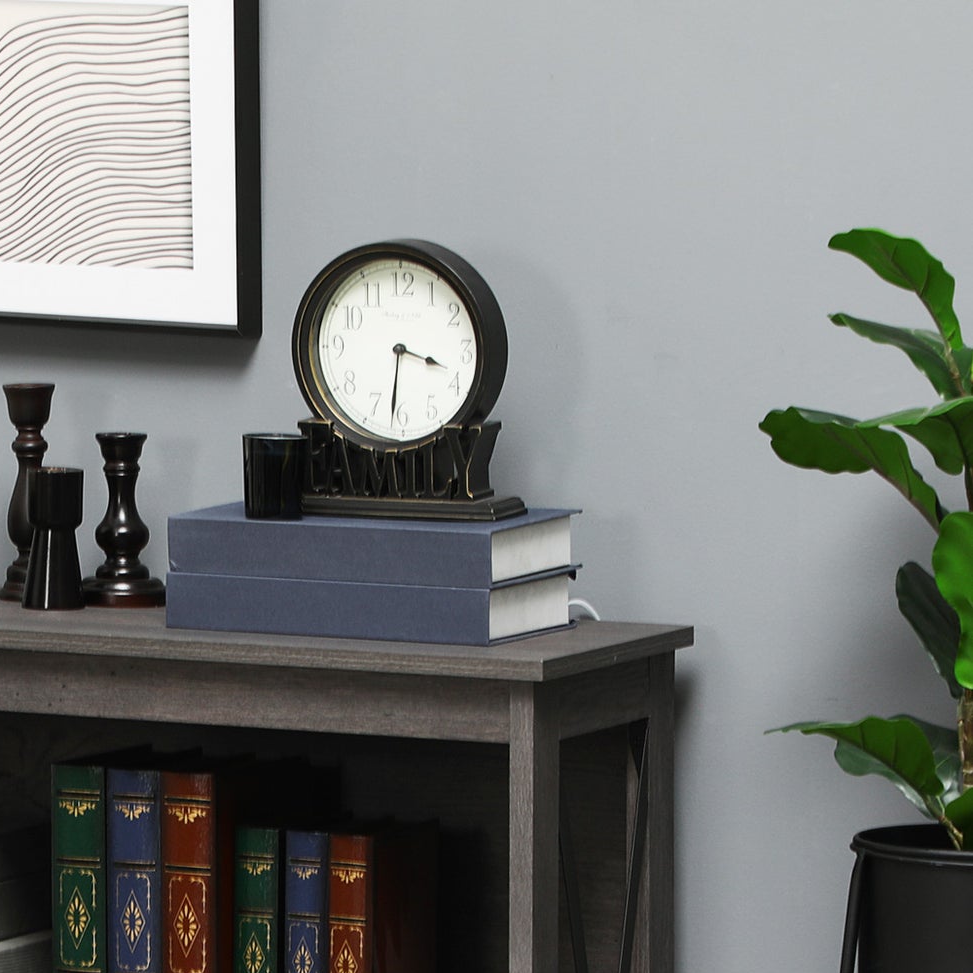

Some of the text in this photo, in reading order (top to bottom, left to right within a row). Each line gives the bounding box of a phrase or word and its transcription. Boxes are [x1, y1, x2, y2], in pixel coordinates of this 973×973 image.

[363, 281, 381, 308] 11
[390, 271, 415, 297] 12
[427, 281, 435, 307] 1
[343, 304, 363, 331] 10
[447, 302, 461, 328] 2
[333, 335, 345, 360] 9
[460, 339, 473, 365] 3
[343, 370, 357, 396] 8
[448, 371, 460, 397] 4
[369, 392, 382, 417] 7
[396, 401, 409, 427] 6
[427, 395, 438, 420] 5
[298, 420, 481, 499] FAMILY
